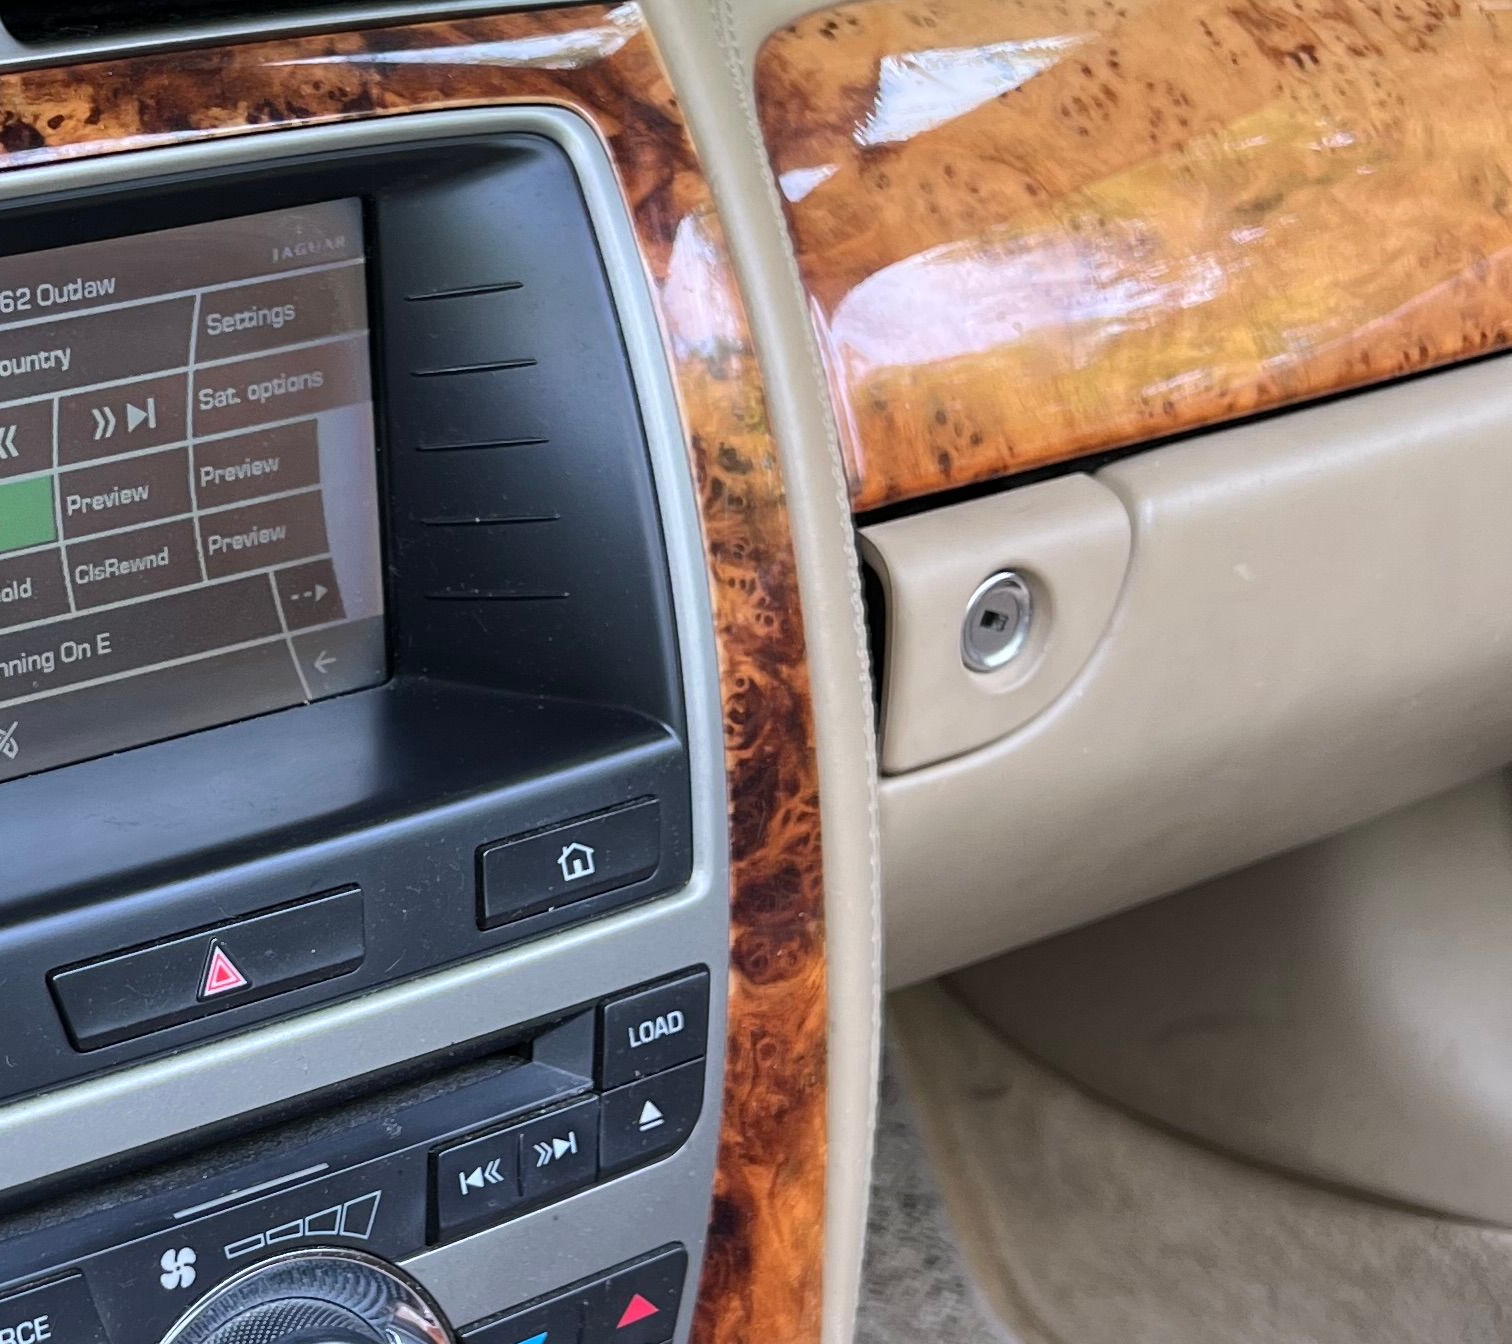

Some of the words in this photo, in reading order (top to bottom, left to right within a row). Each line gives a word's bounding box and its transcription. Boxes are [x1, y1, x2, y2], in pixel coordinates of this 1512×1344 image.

[272, 235, 347, 264] JAGUAR
[37, 274, 116, 307] Outlaw
[206, 302, 296, 337] Settings
[246, 369, 324, 402] options
[200, 454, 280, 487] Preview
[66, 481, 150, 516] Preview
[208, 522, 286, 555] Preview
[60, 637, 93, 663] On
[96, 633, 112, 655] E
[627, 1009, 685, 1048] LOAD
